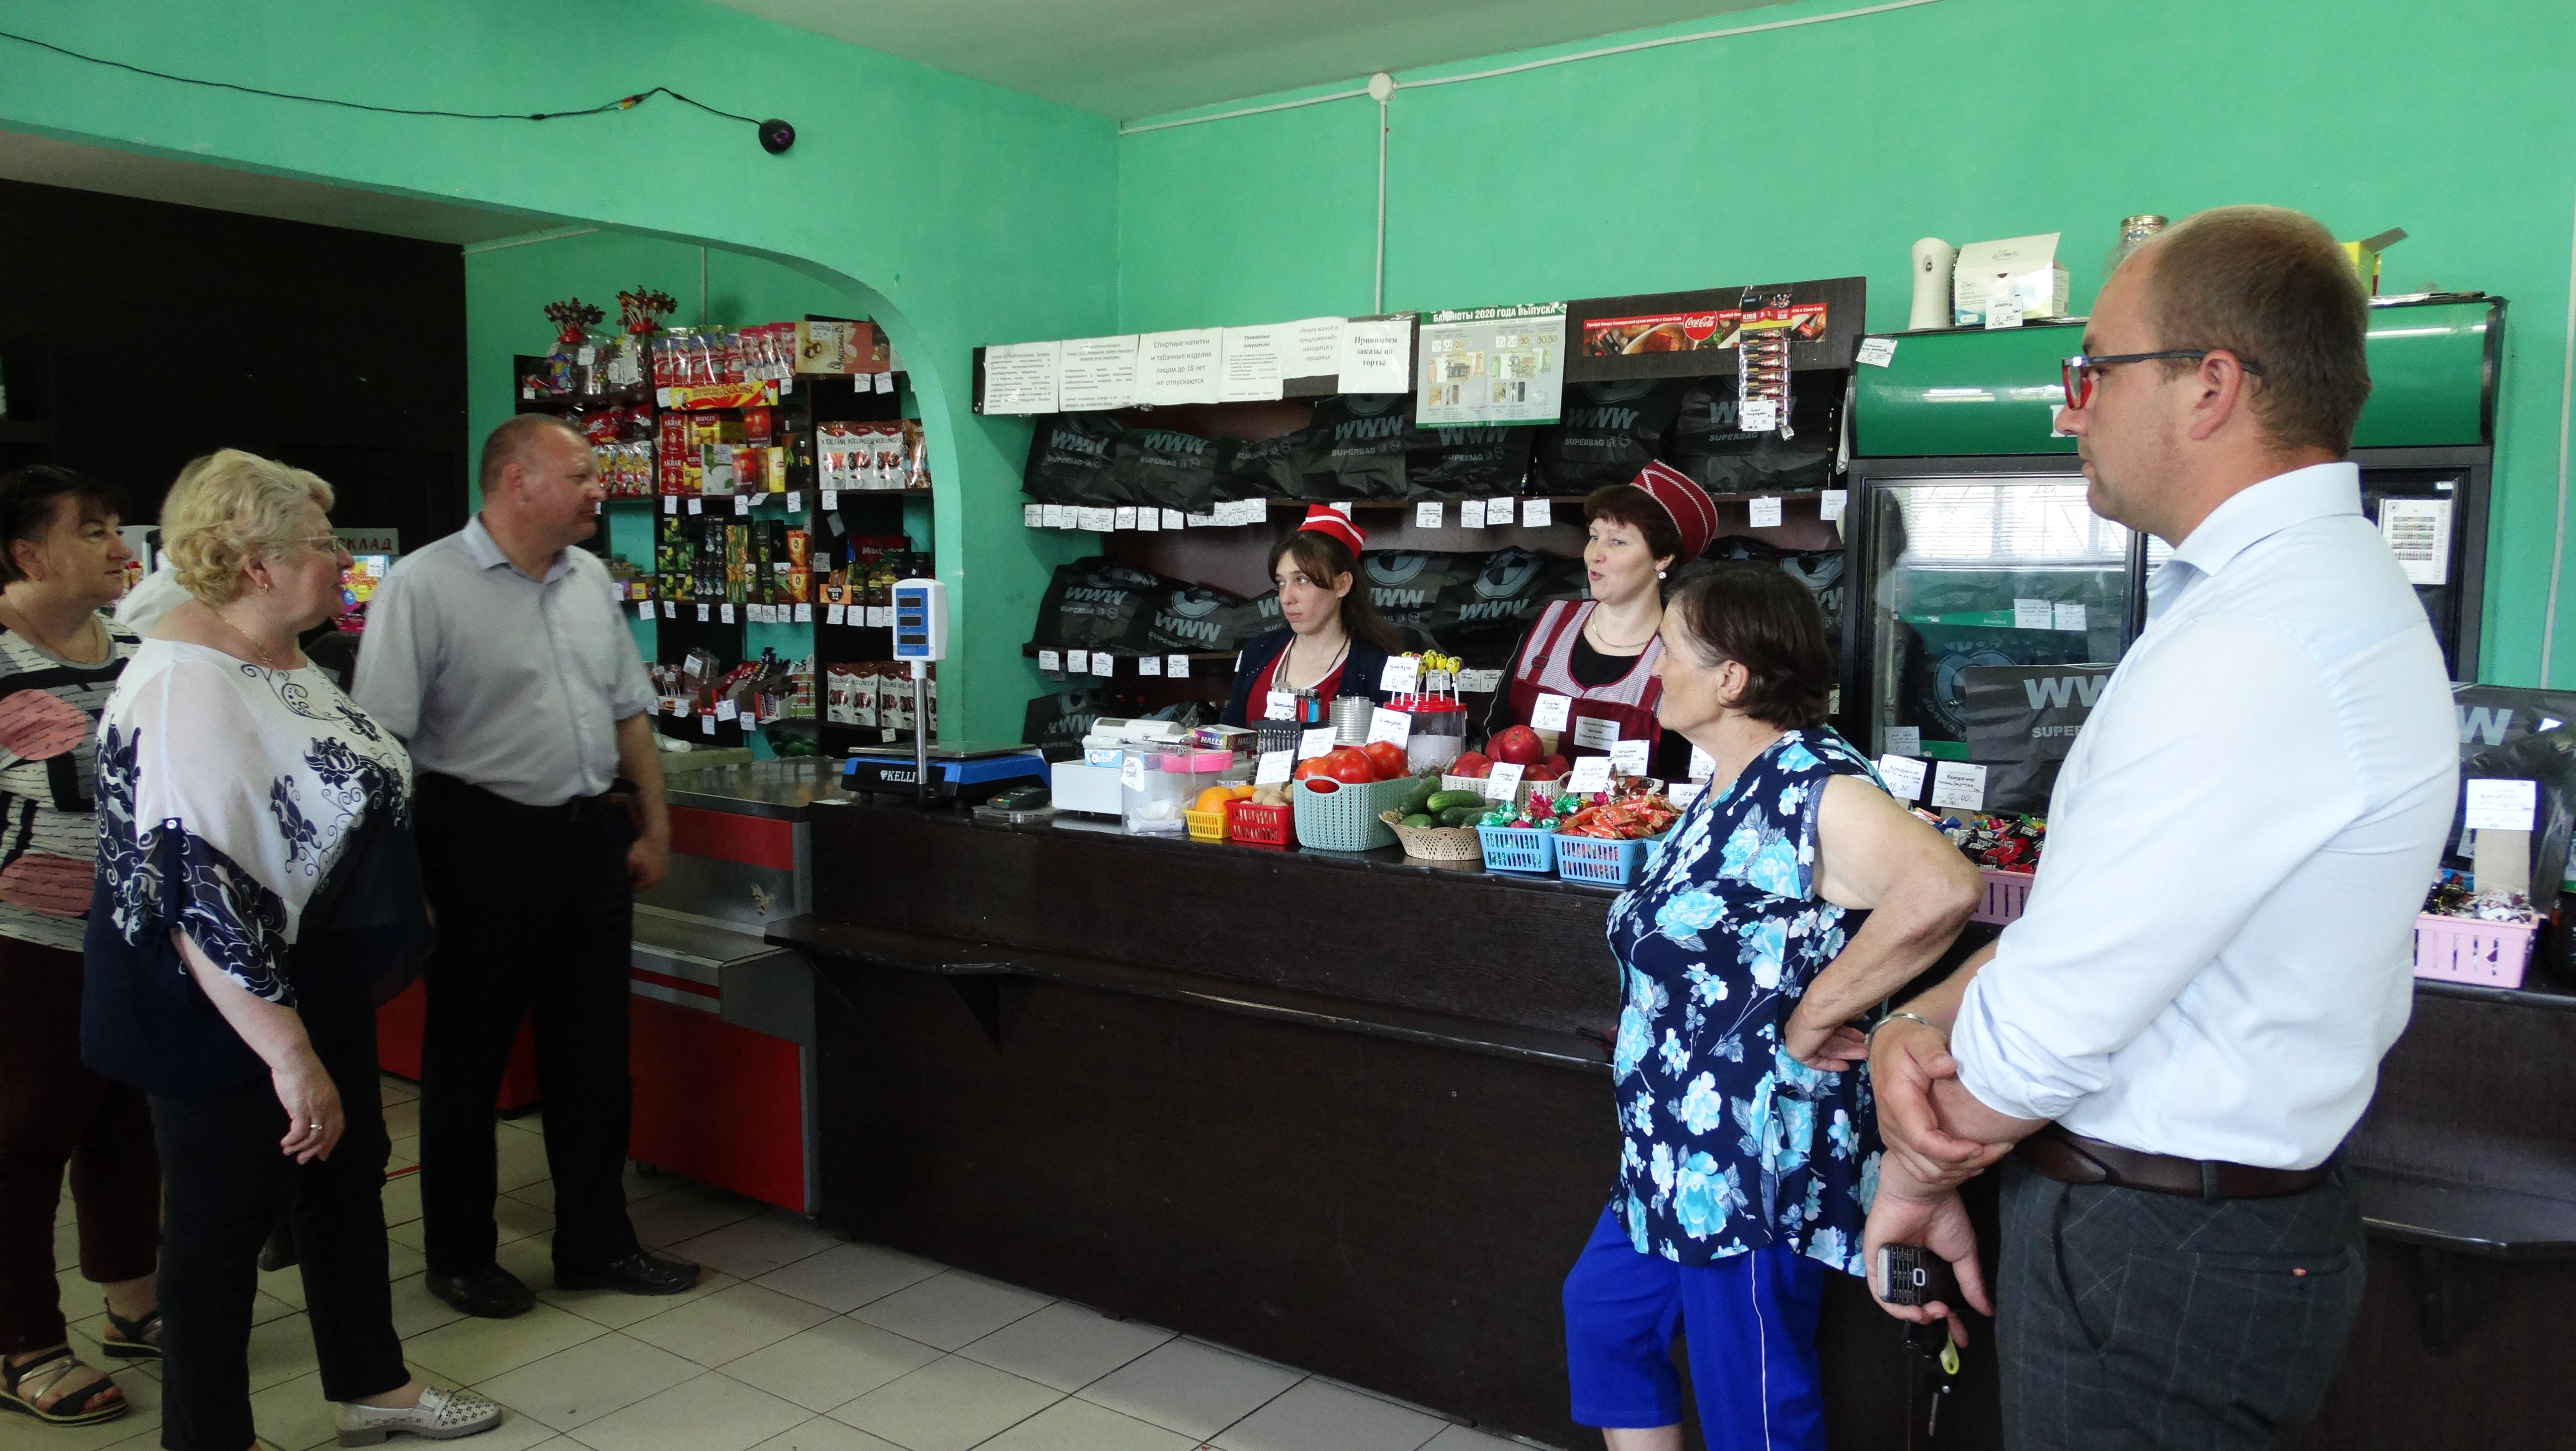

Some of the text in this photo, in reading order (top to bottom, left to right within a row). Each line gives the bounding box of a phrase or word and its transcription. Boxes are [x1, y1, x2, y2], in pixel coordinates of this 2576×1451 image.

[1433, 306, 1555, 322] БАНОТЫ 2020 ГОДА ВЫПУСКА
[1685, 316, 1716, 328] Coca-Cola
[1299, 334, 1337, 343] предложений»
[1354, 336, 1397, 345] Принимаем
[1363, 359, 1385, 368] торты
[1567, 408, 1639, 430] WWW
[1335, 415, 1405, 441] WWW
[1564, 437, 1605, 447] SUPERBAG
[1709, 431, 1758, 442] SUPERBAG
[1144, 433, 1212, 455] WWW
[1332, 448, 1376, 457] SUPERBAG
[1064, 587, 1128, 605] WWW
[1459, 598, 1530, 620] WWW
[1155, 611, 1221, 642] WWW
[1201, 736, 1223, 746] HALLS
[1237, 735, 1255, 745] HALLS
[1090, 751, 1114, 765] Orbit
[887, 770, 915, 783] KELLI
